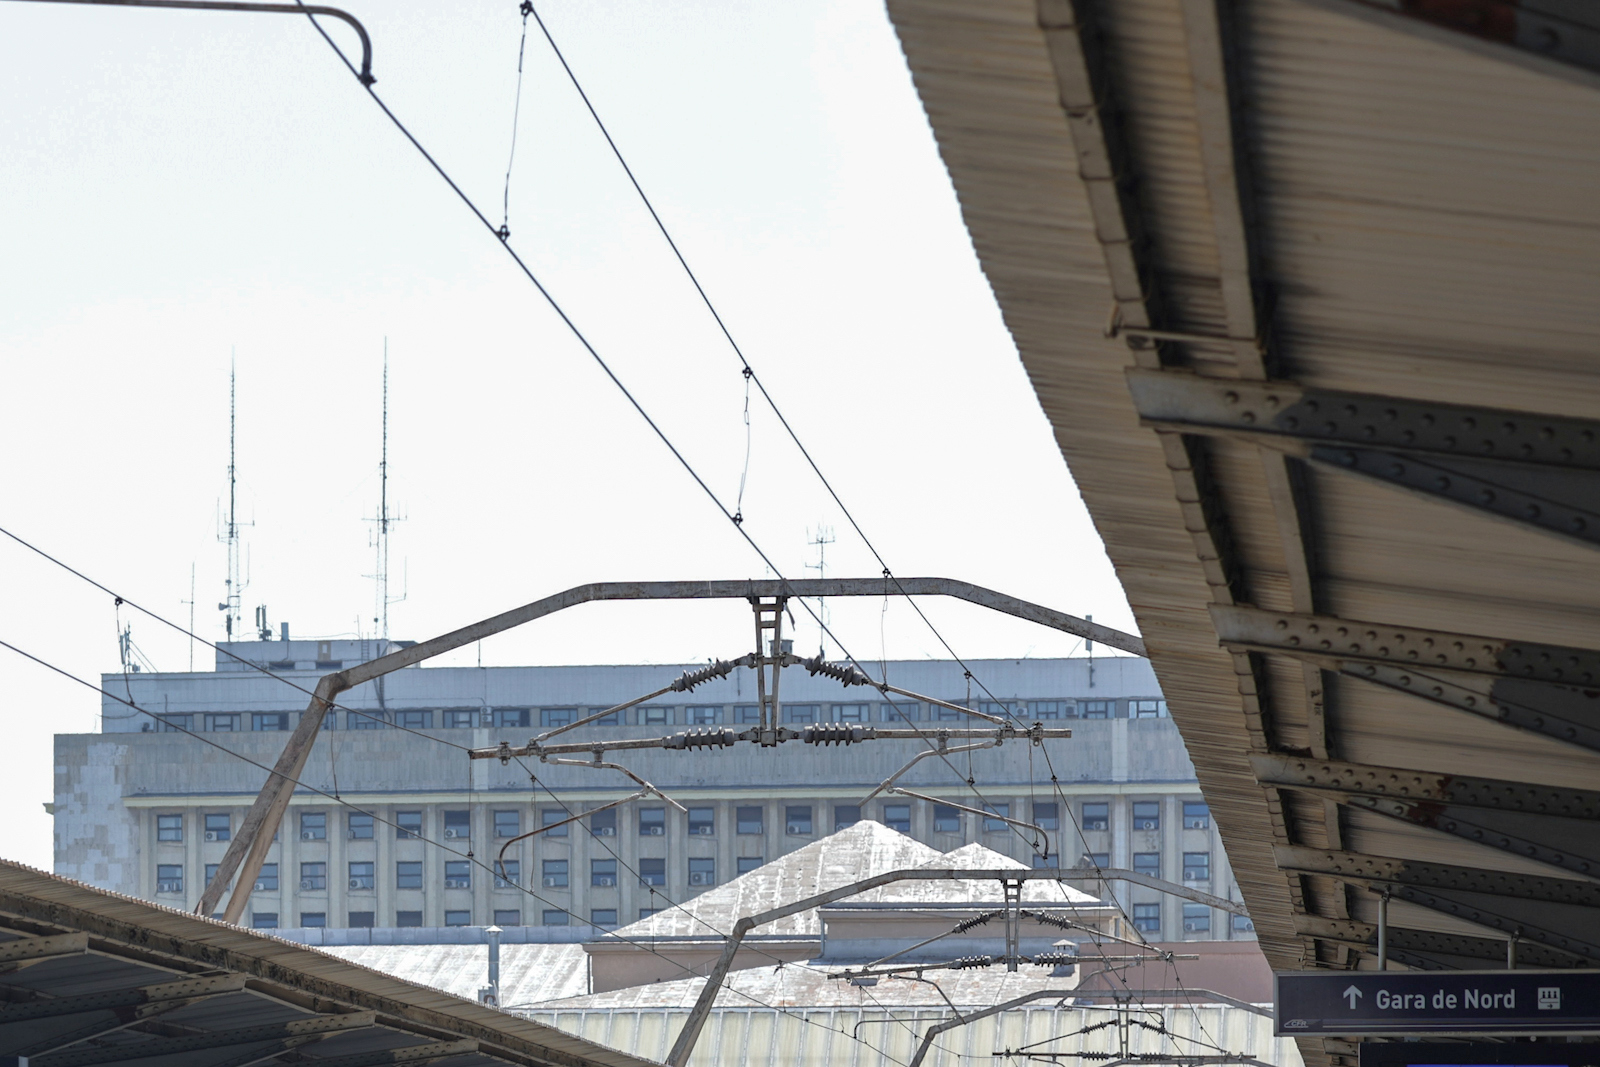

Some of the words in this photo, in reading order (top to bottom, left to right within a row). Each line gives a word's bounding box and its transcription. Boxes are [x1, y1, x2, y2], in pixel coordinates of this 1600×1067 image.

[1375, 989, 1426, 1010] Gara
[1432, 989, 1458, 1010] de
[1464, 989, 1516, 1009] Nord
